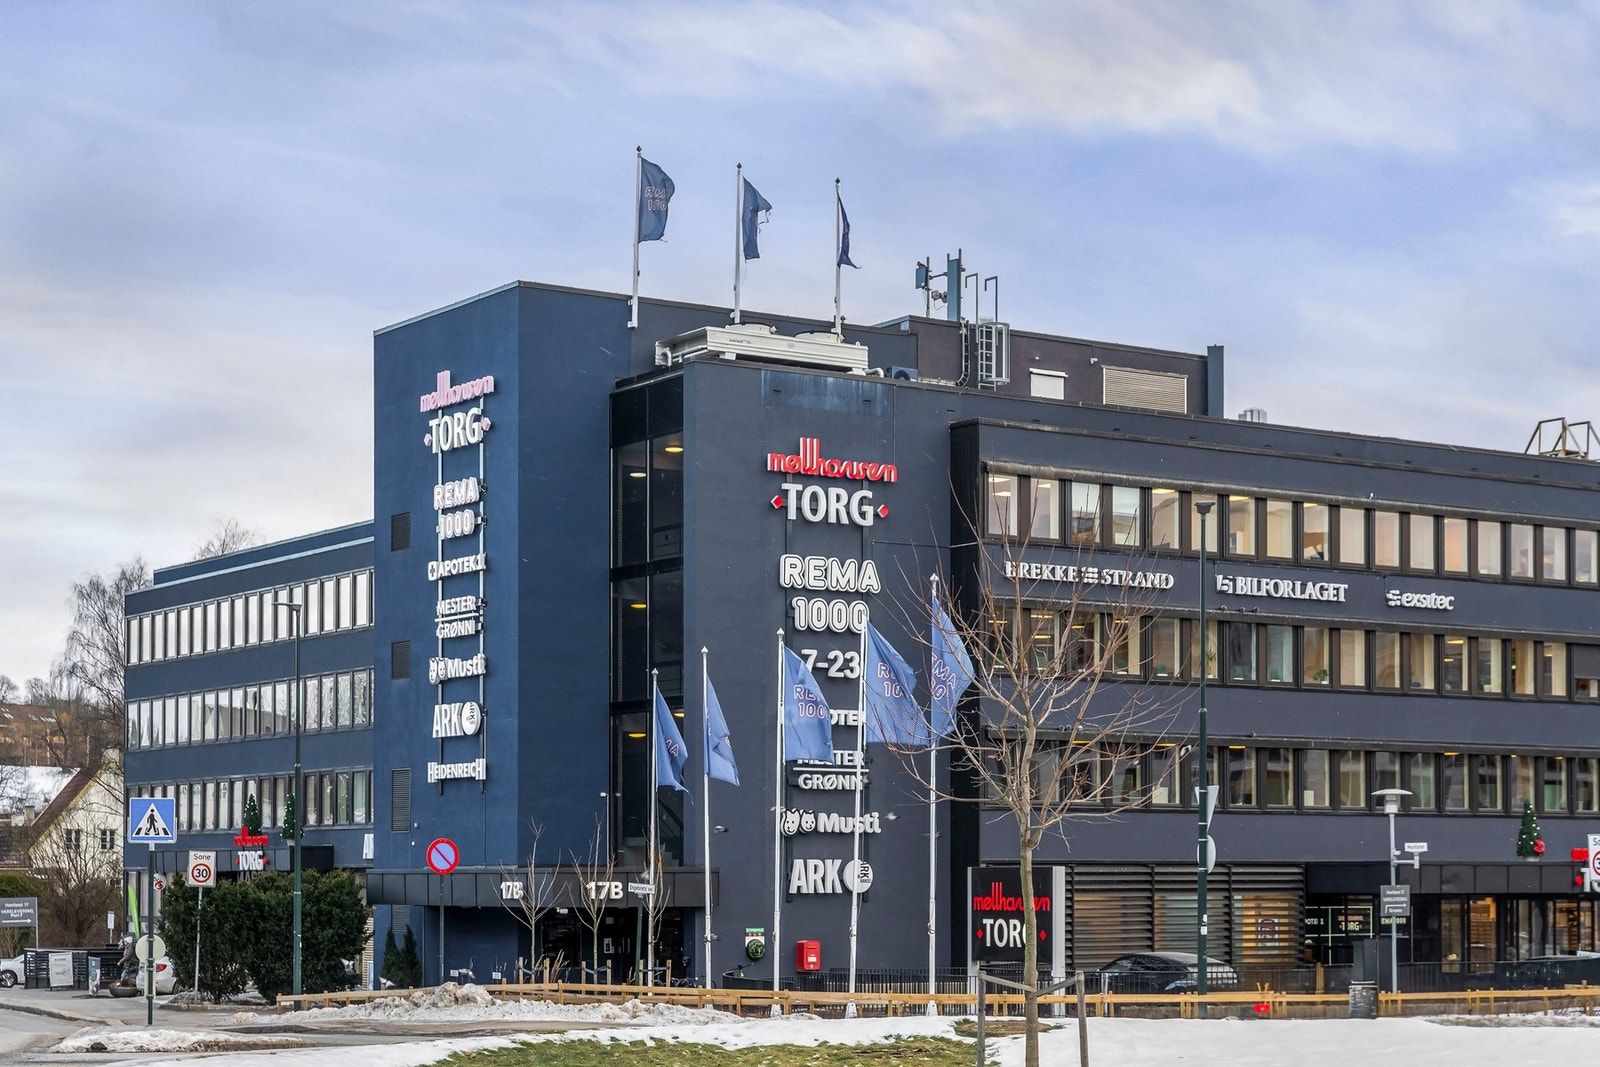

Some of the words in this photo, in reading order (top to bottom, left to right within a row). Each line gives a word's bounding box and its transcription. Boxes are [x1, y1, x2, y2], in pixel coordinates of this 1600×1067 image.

[429, 407, 484, 454] TORG
[433, 477, 480, 510] REMA
[781, 483, 874, 527] TORG
[439, 509, 475, 540] 1000
[780, 554, 881, 594] REMA
[1004, 561, 1079, 582] BREKKE
[1101, 569, 1175, 589] STRAND
[1235, 576, 1349, 602] BILFORLAGET
[437, 596, 476, 616] MESTER
[791, 597, 870, 634] 1000
[437, 620, 475, 639] GRØNN
[447, 653, 486, 678] Musti
[801, 648, 861, 680] 7-23
[432, 703, 464, 738] ARK
[427, 758, 486, 783] HEIDENREICH
[798, 773, 863, 790] GRØNN
[817, 812, 881, 834] Musti
[193, 853, 212, 861] Sone
[237, 850, 265, 871] TORG
[195, 868, 209, 878] 30
[787, 859, 843, 894] ARK
[500, 881, 524, 899] 17B
[586, 881, 624, 900] 17B
